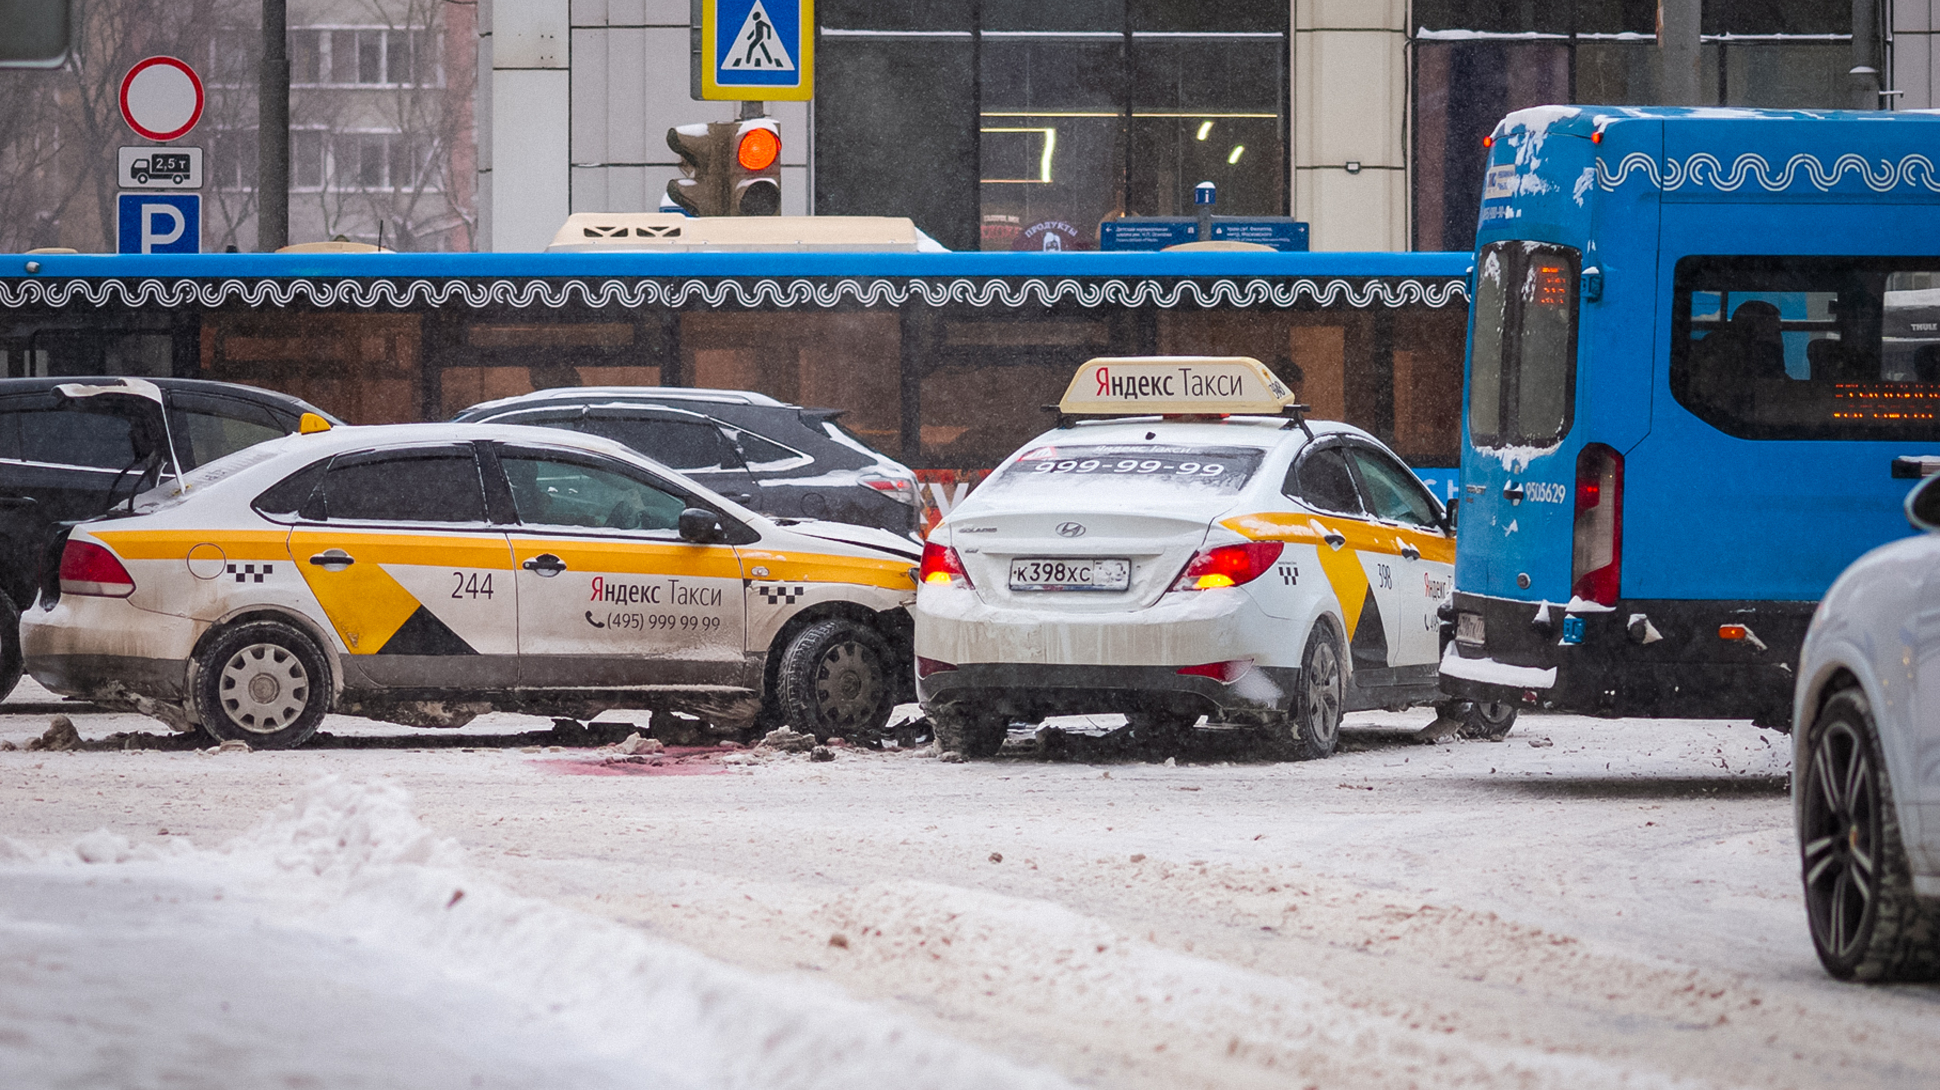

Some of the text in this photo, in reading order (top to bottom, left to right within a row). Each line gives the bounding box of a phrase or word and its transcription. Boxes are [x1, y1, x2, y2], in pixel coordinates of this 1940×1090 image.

[155, 158, 176, 171] 2,5
[141, 203, 186, 254] P
[1024, 220, 1079, 239] ПРОДУКТЫ
[1910, 323, 1938, 332] THULE
[1095, 367, 1243, 400] Яндекс Такси
[1032, 459, 1226, 477] 999-99-99
[1525, 482, 1567, 504] 9505629
[451, 571, 494, 600] 244
[1377, 563, 1393, 590] 398
[590, 576, 723, 607] Яндекс Такси
[607, 613, 721, 632] (495) 999 99 99
